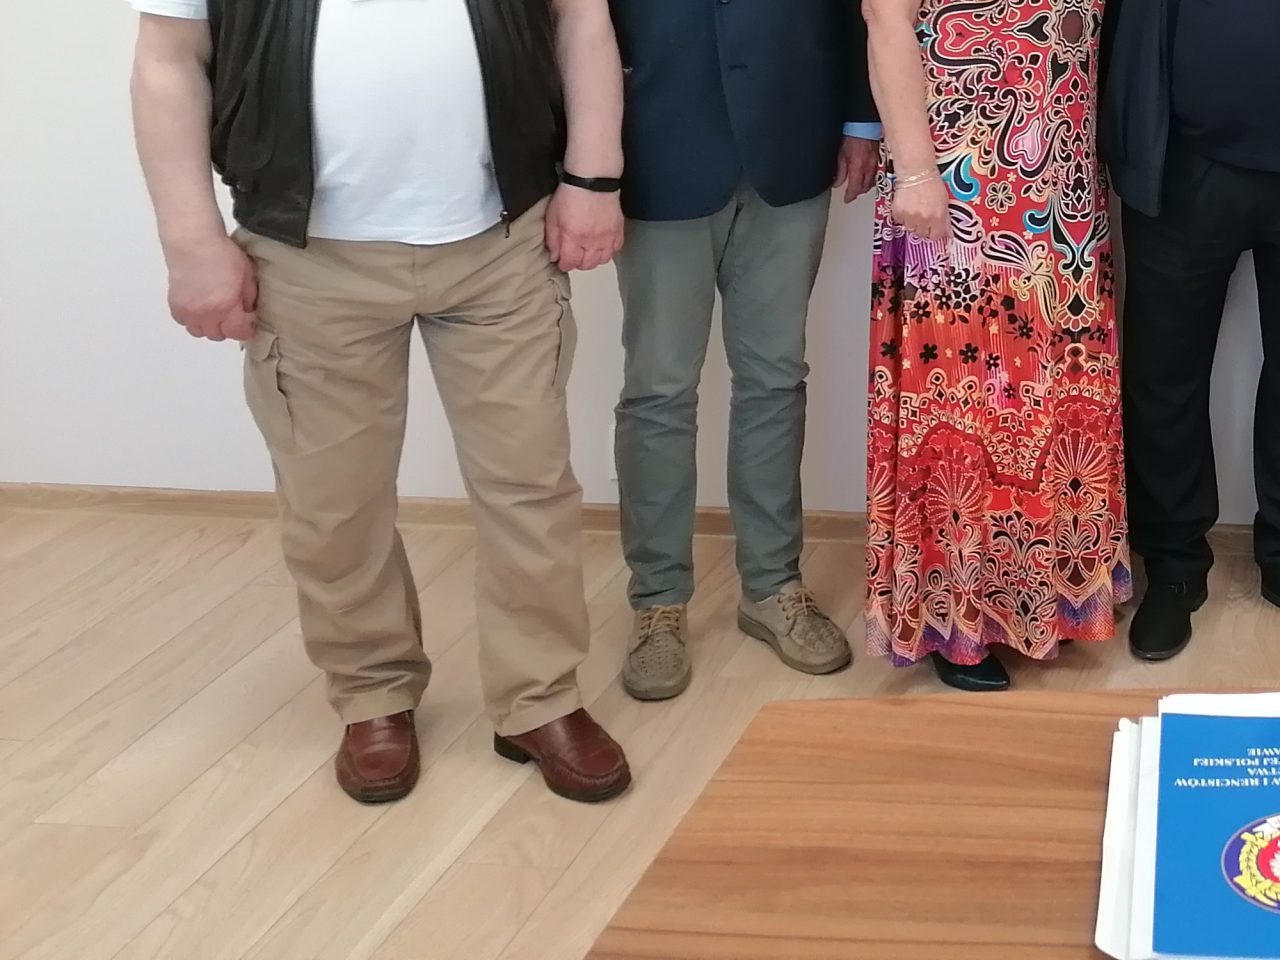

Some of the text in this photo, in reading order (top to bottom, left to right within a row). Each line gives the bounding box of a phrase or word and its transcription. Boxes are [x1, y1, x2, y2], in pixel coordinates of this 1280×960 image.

[1193, 757, 1259, 766] POLSKIEJ
[1174, 777, 1259, 788] RENCISTÓW
[1263, 777, 1268, 786] I
